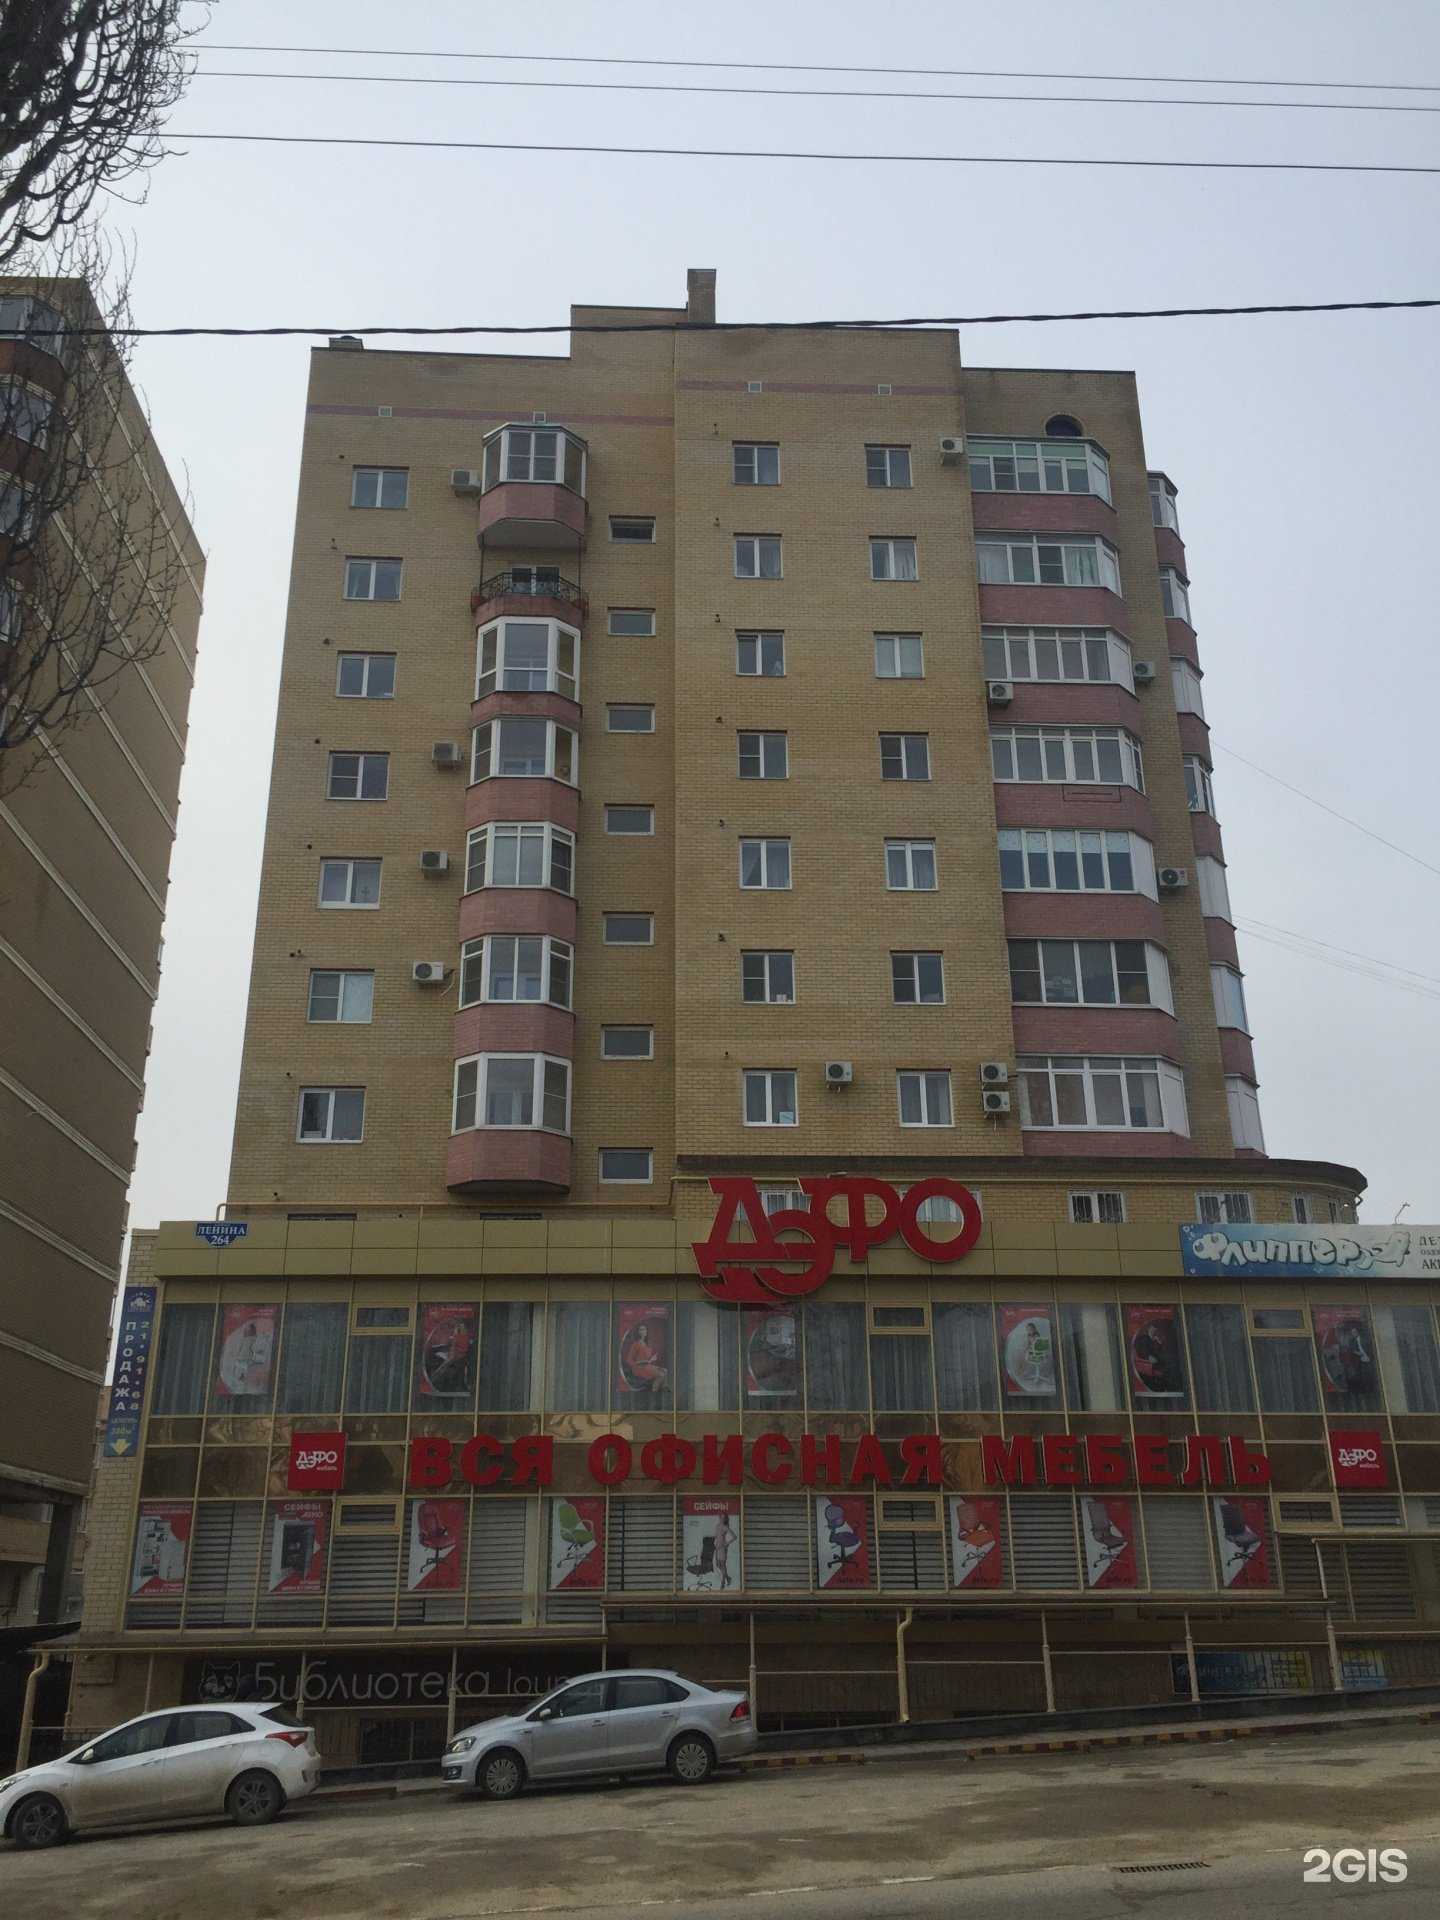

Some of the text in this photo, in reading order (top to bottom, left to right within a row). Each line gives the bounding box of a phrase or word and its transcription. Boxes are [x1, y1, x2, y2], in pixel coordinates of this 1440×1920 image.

[197, 1226, 246, 1235] ЛЕНИНА
[210, 1235, 231, 1246] 264
[691, 1176, 983, 1303] ДЭФО
[114, 1321, 137, 1411] ПРОДАЖА
[411, 1433, 1272, 1487] ВСЯ ОФИСНАЯ МЕБЕЛЬ
[255, 1661, 490, 1700] Библиотека
